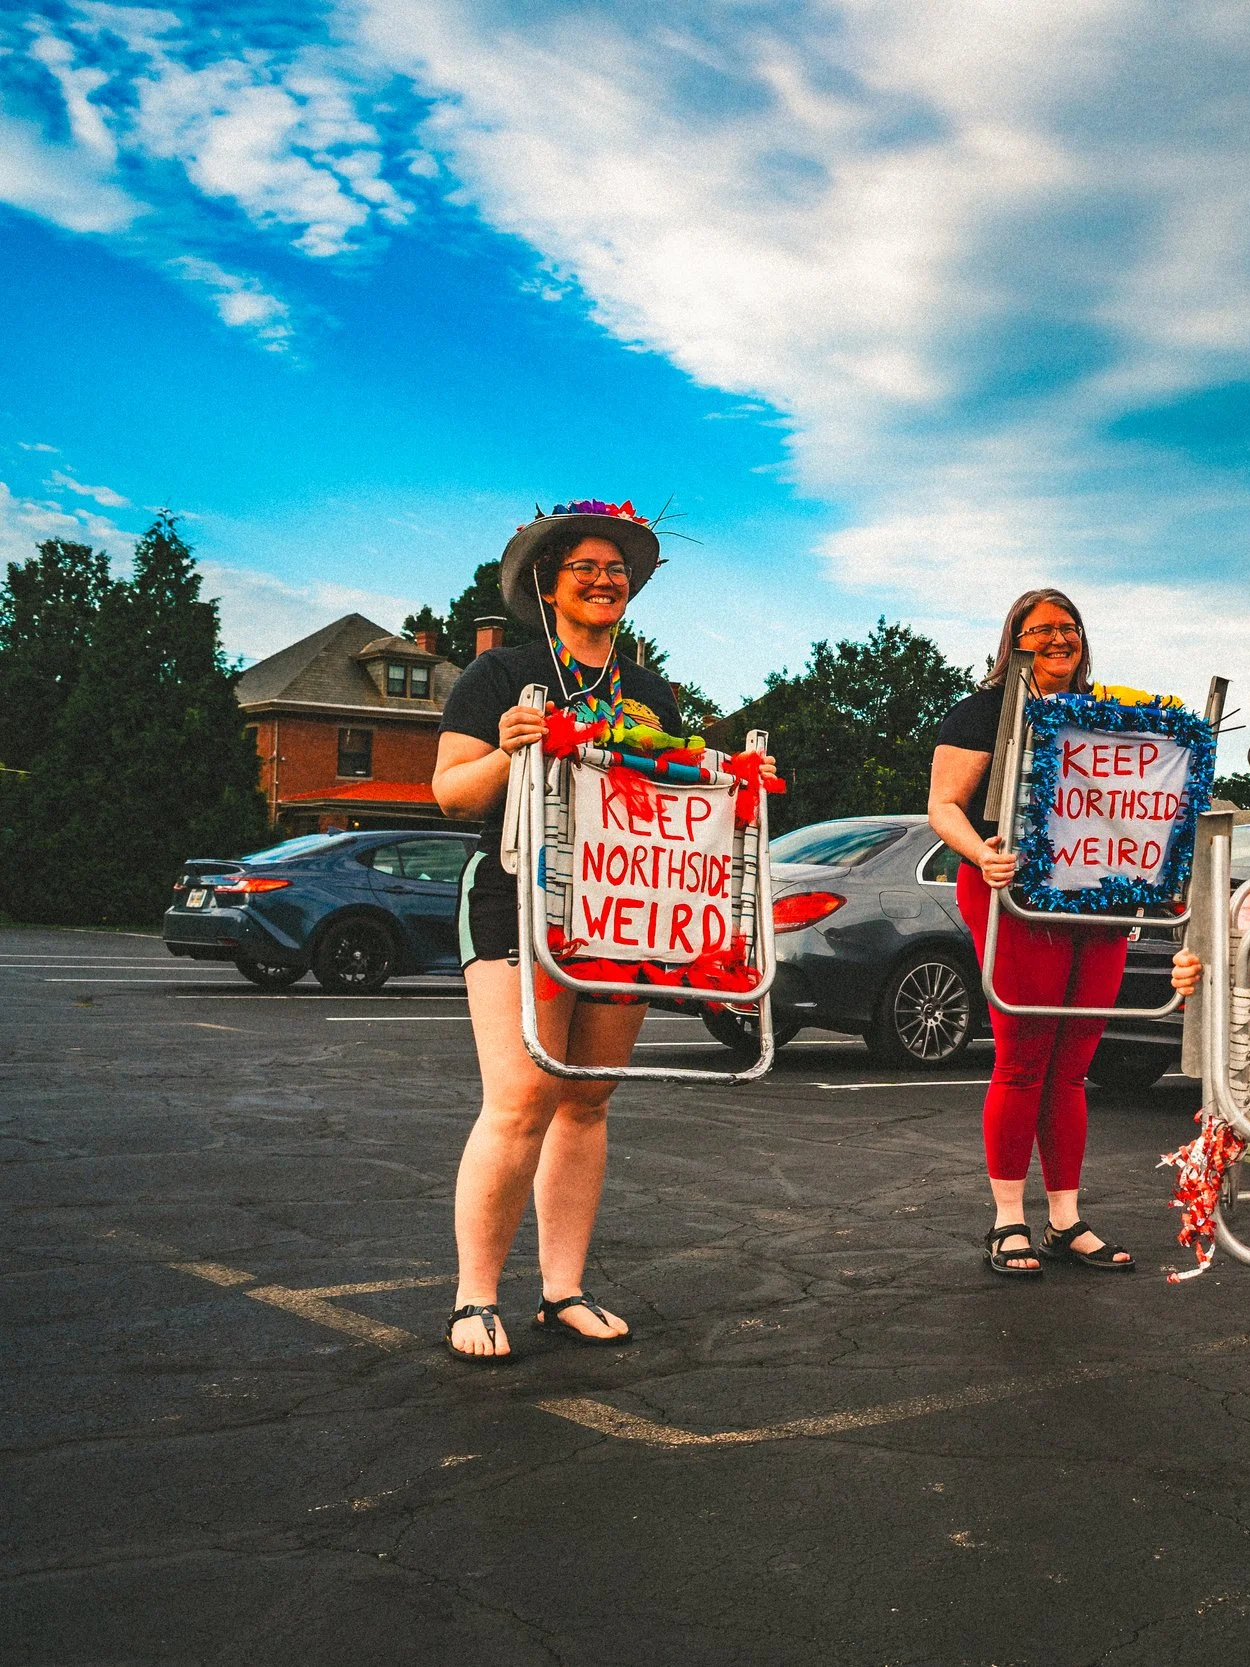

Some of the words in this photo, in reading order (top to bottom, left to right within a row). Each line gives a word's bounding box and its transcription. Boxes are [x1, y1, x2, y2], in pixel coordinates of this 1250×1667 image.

[1062, 740, 1159, 780] KEEP
[1051, 787, 1190, 821] NORTHSIDE
[582, 841, 732, 899] NORTHSIDE
[1051, 837, 1161, 870] WEIRD
[581, 896, 726, 955] WEIRD
